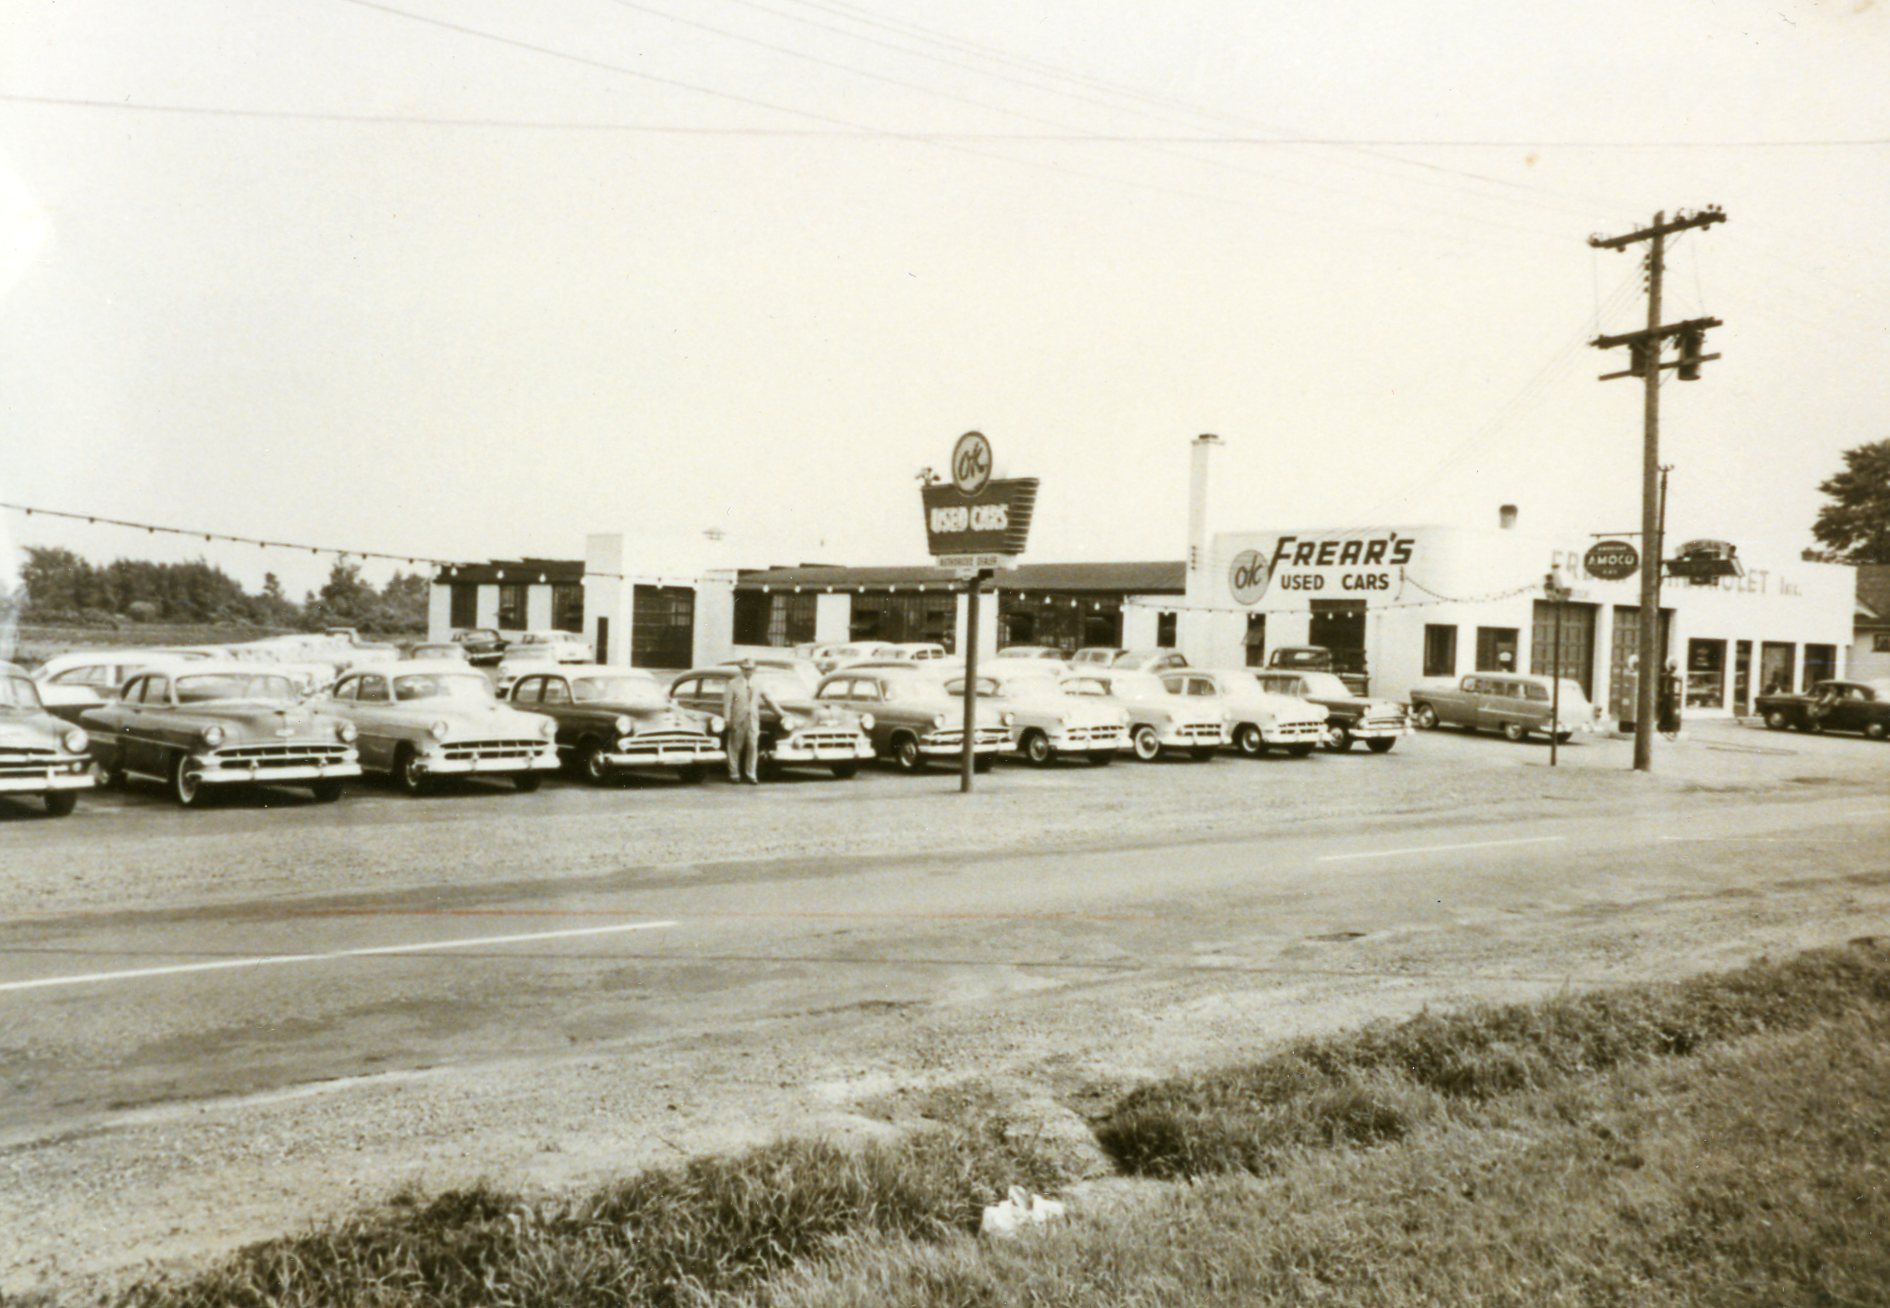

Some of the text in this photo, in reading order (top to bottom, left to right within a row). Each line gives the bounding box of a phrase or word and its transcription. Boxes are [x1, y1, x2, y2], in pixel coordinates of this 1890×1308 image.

[1267, 532, 1416, 582] FREAR'S
[1587, 554, 1635, 566] AMOCO
[1281, 573, 1390, 591] USED CARS
